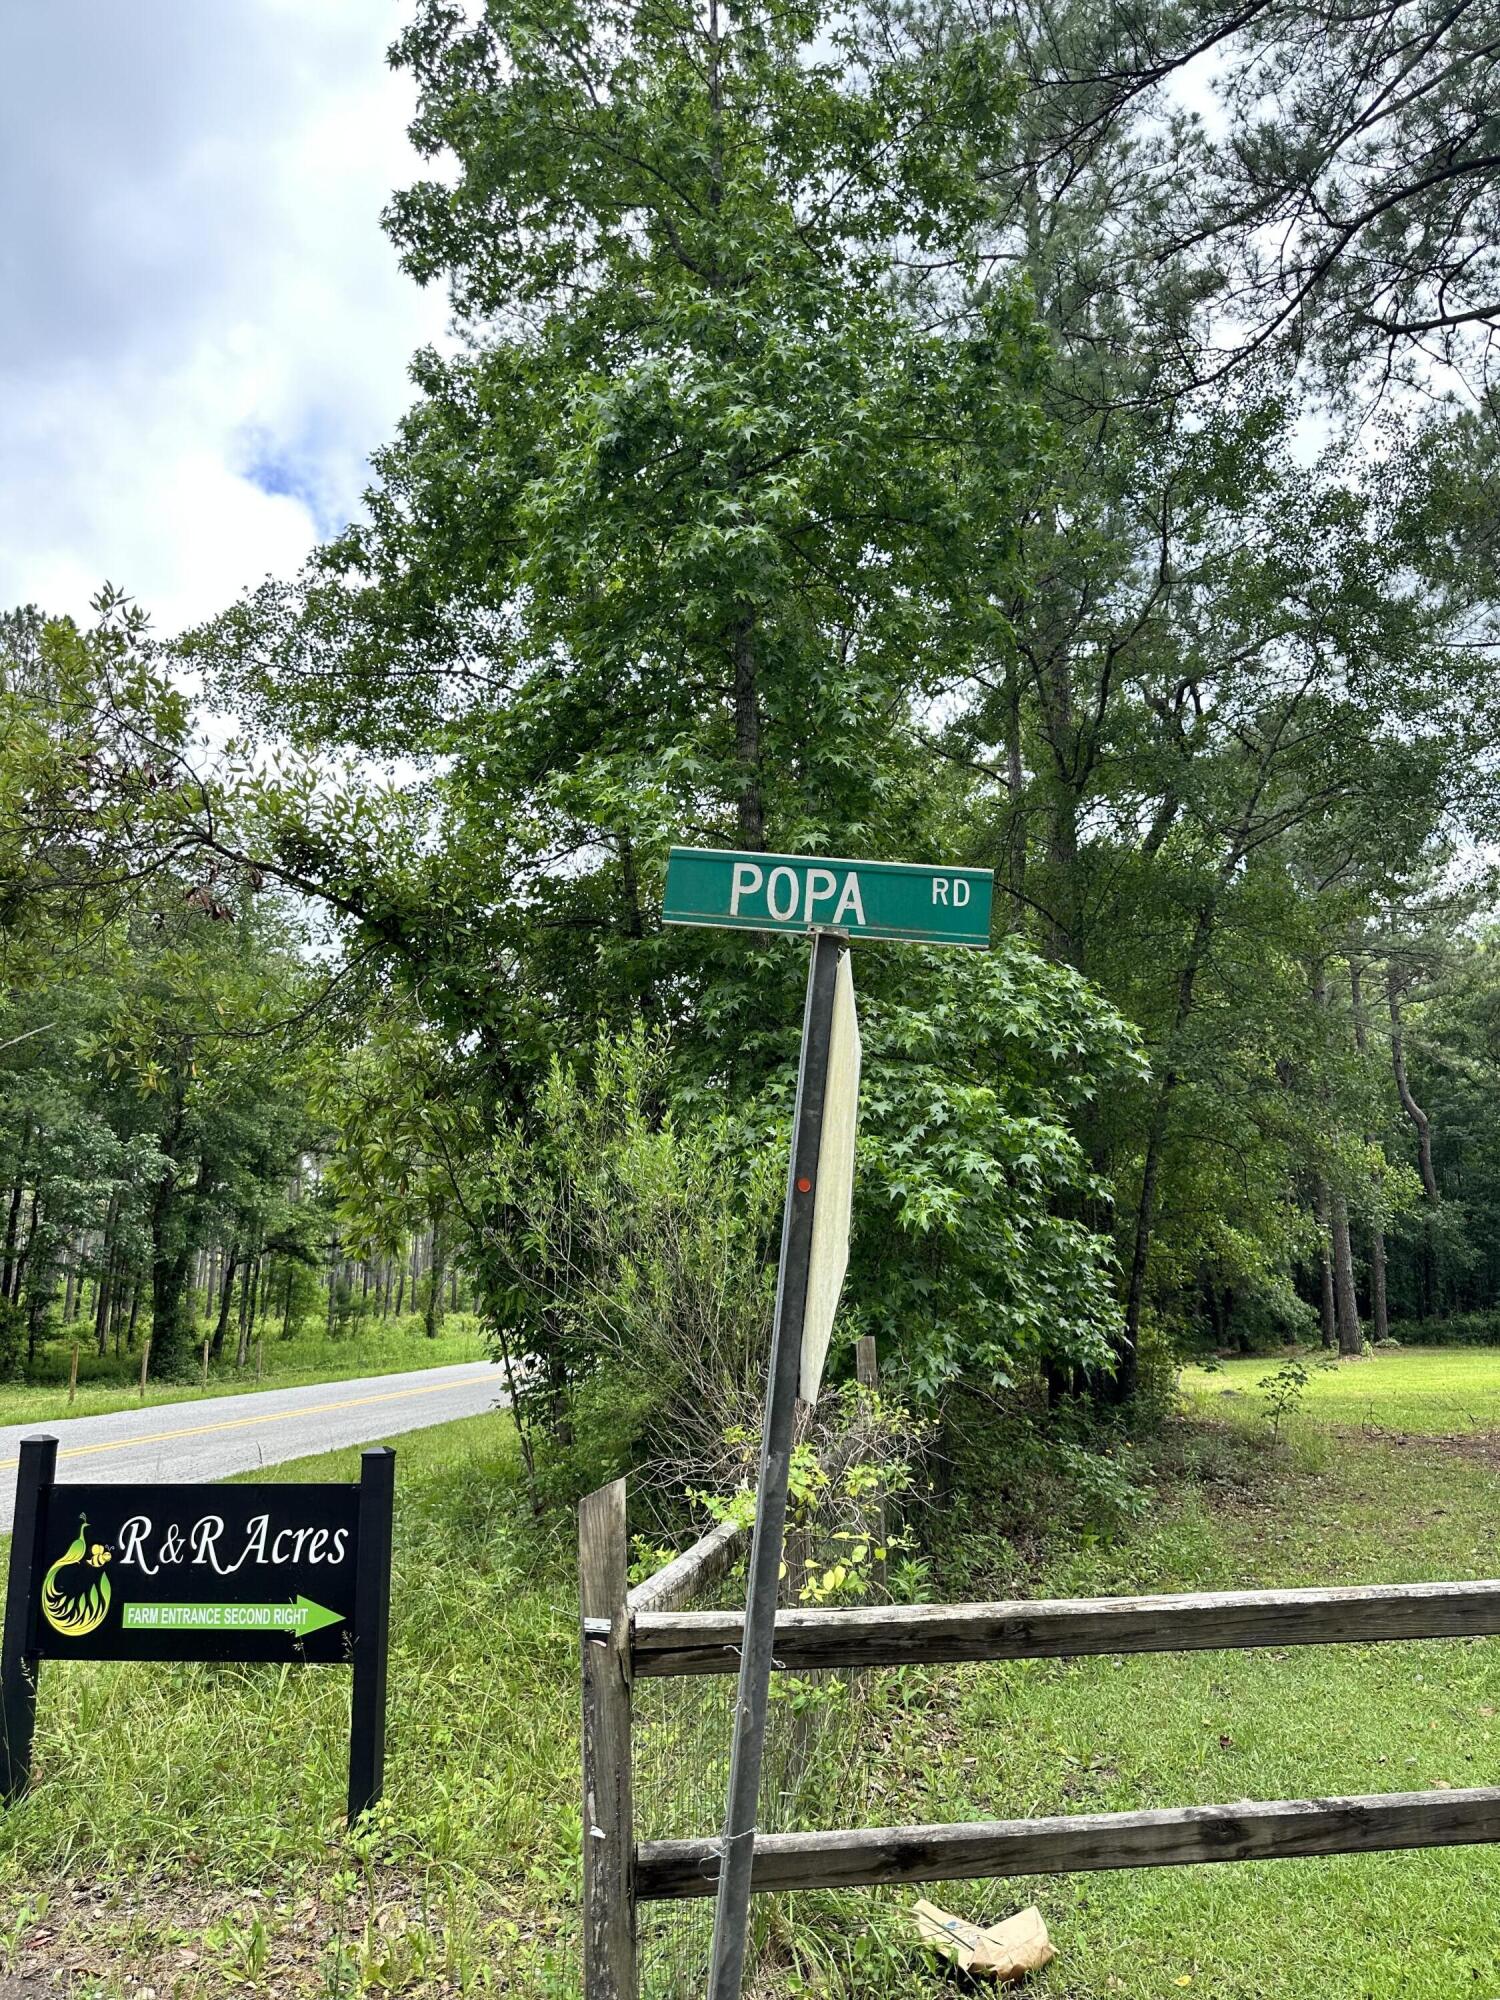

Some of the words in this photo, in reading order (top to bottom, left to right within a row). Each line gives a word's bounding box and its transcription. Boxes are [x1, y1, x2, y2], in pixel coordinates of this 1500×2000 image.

[730, 863, 866, 925] POPA
[932, 878, 970, 907] RD
[231, 1514, 348, 1573] Acres
[127, 1607, 159, 1625] FARM
[161, 1607, 221, 1625] ENTRANCE
[223, 1608, 271, 1625] SECOND
[273, 1608, 308, 1625] RIGHT
